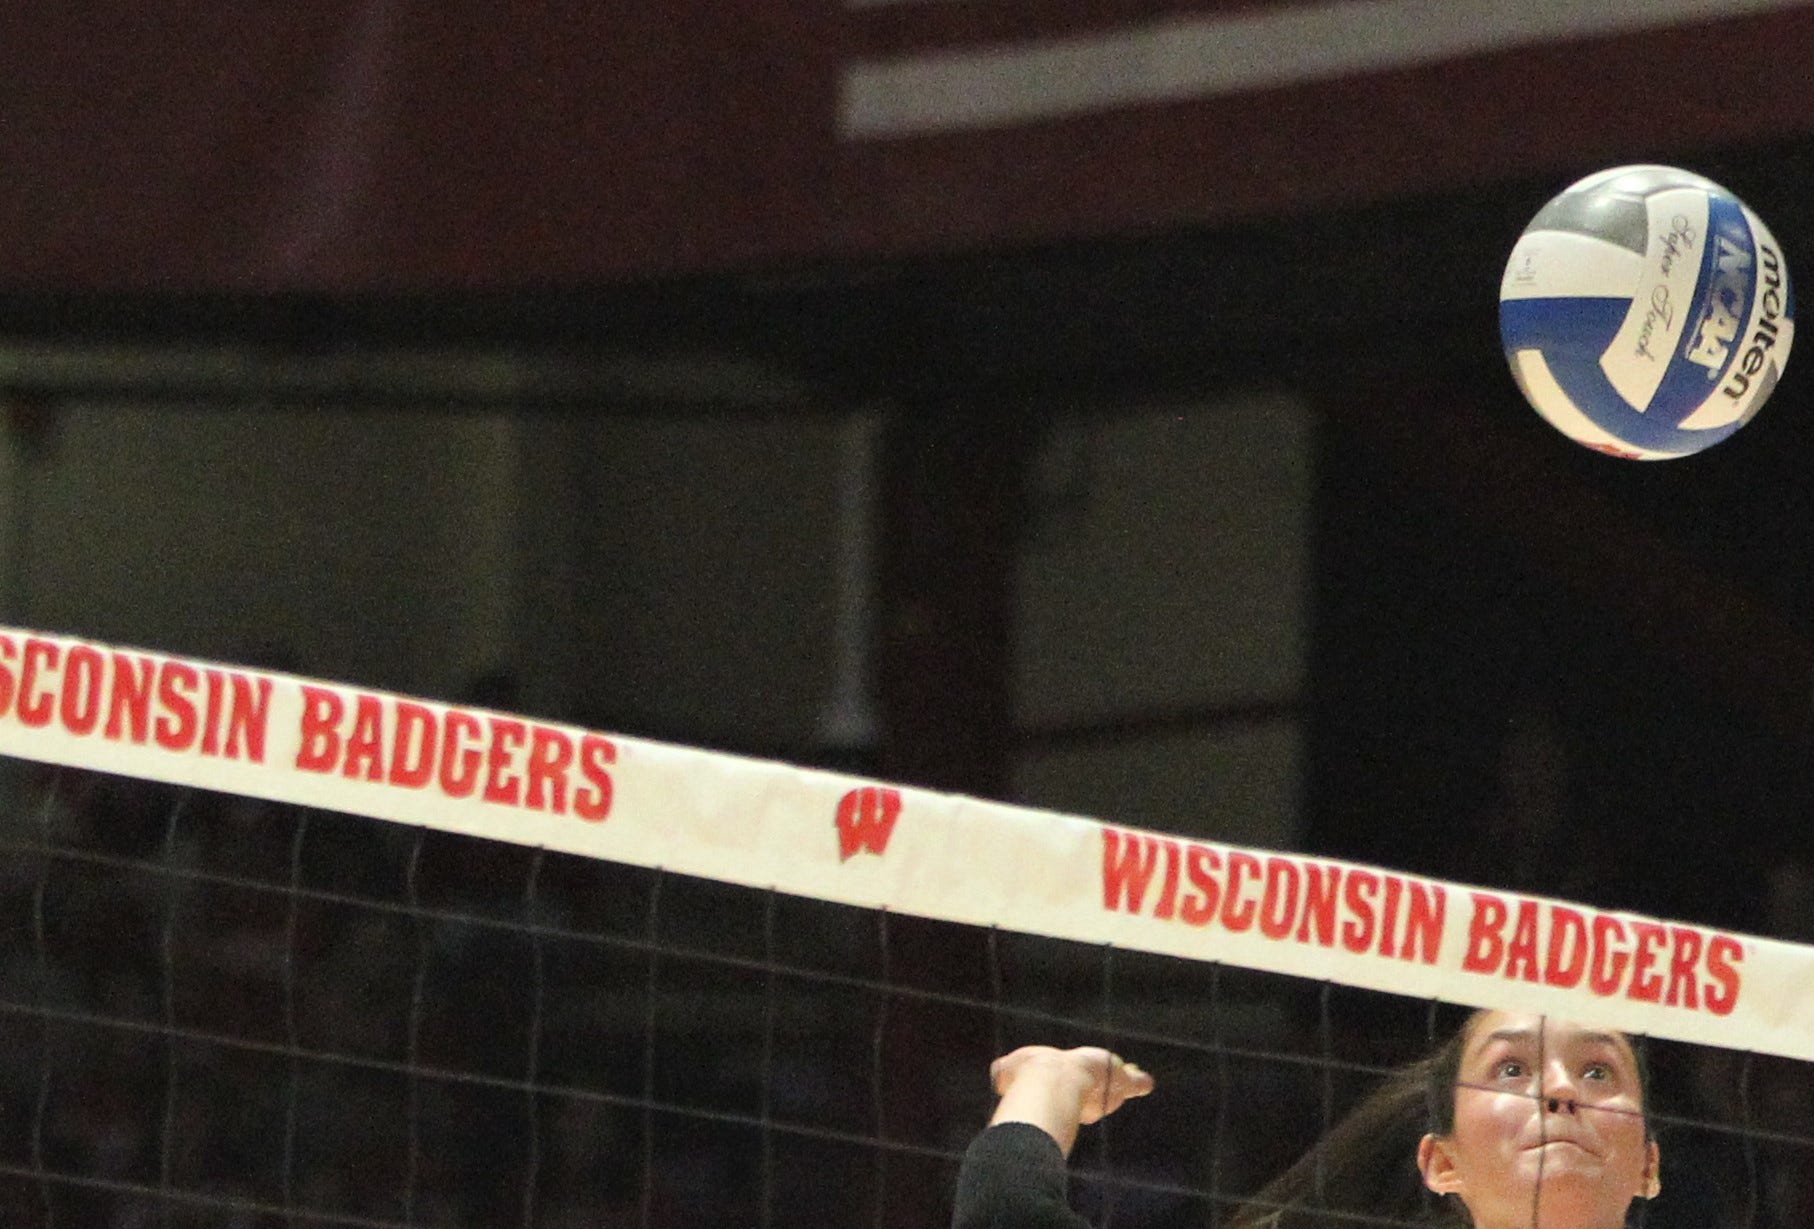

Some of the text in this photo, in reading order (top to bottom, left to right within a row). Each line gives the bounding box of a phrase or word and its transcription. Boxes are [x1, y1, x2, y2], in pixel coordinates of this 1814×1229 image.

[1635, 284, 1674, 362] Touch
[1685, 233, 1753, 370] NCAA
[1723, 244, 1781, 400] molten
[296, 686, 617, 822] BADGERS
[1102, 829, 1745, 1016] WISCONSIN BADGERS
